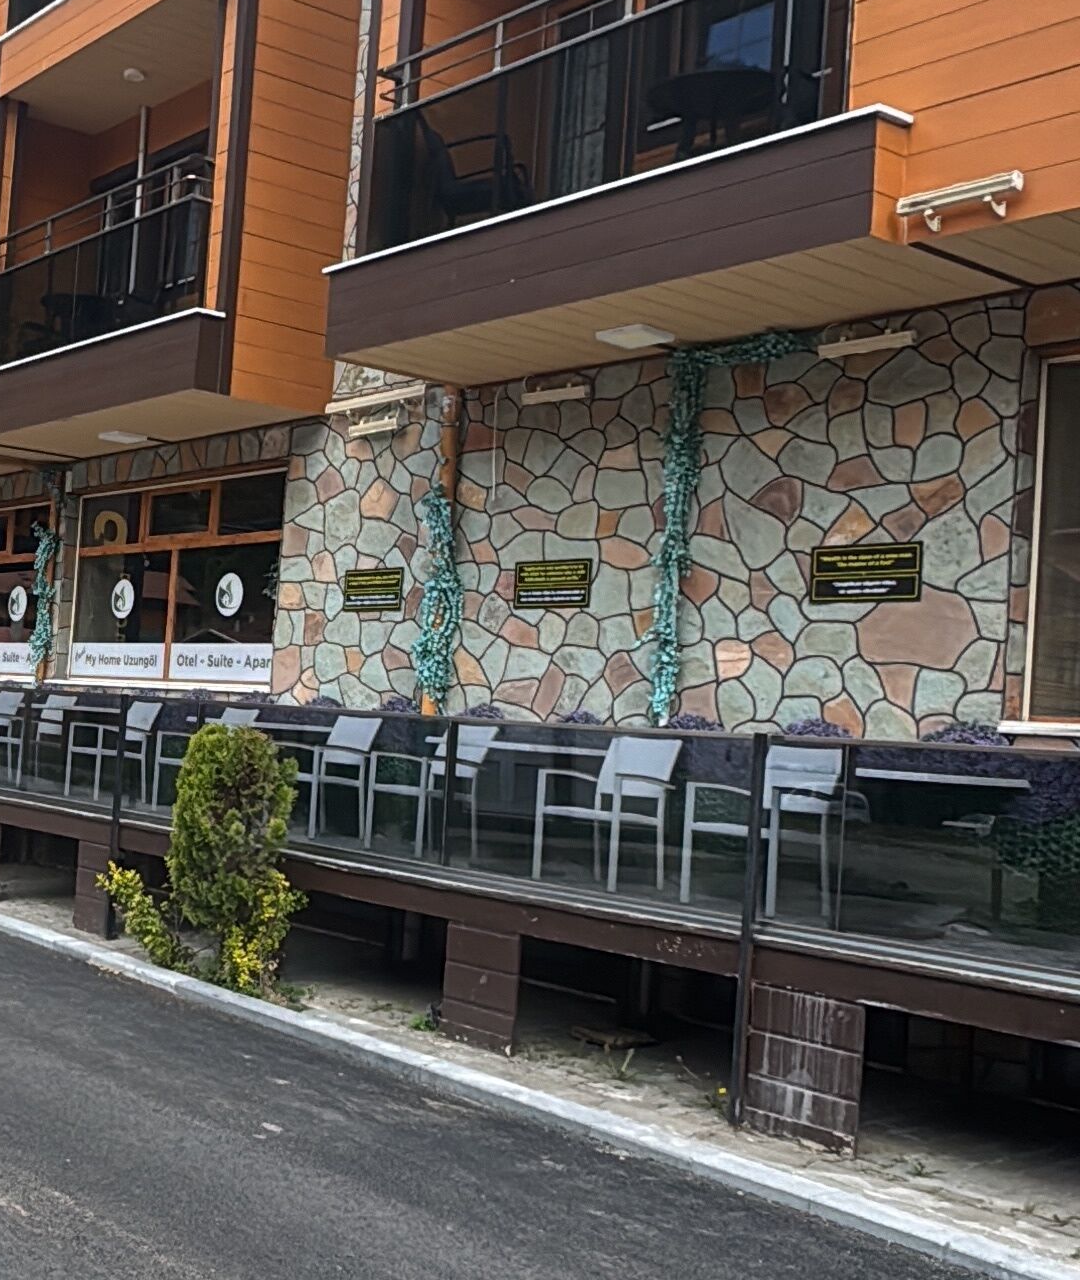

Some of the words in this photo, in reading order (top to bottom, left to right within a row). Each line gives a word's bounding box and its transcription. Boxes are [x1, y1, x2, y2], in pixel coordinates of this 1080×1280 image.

[2, 651, 20, 663] Suite
[85, 654, 98, 667] My
[98, 654, 122, 666] Home
[123, 654, 158, 669] Uzungöl
[176, 653, 198, 667] Otel
[207, 654, 234, 668] Suite
